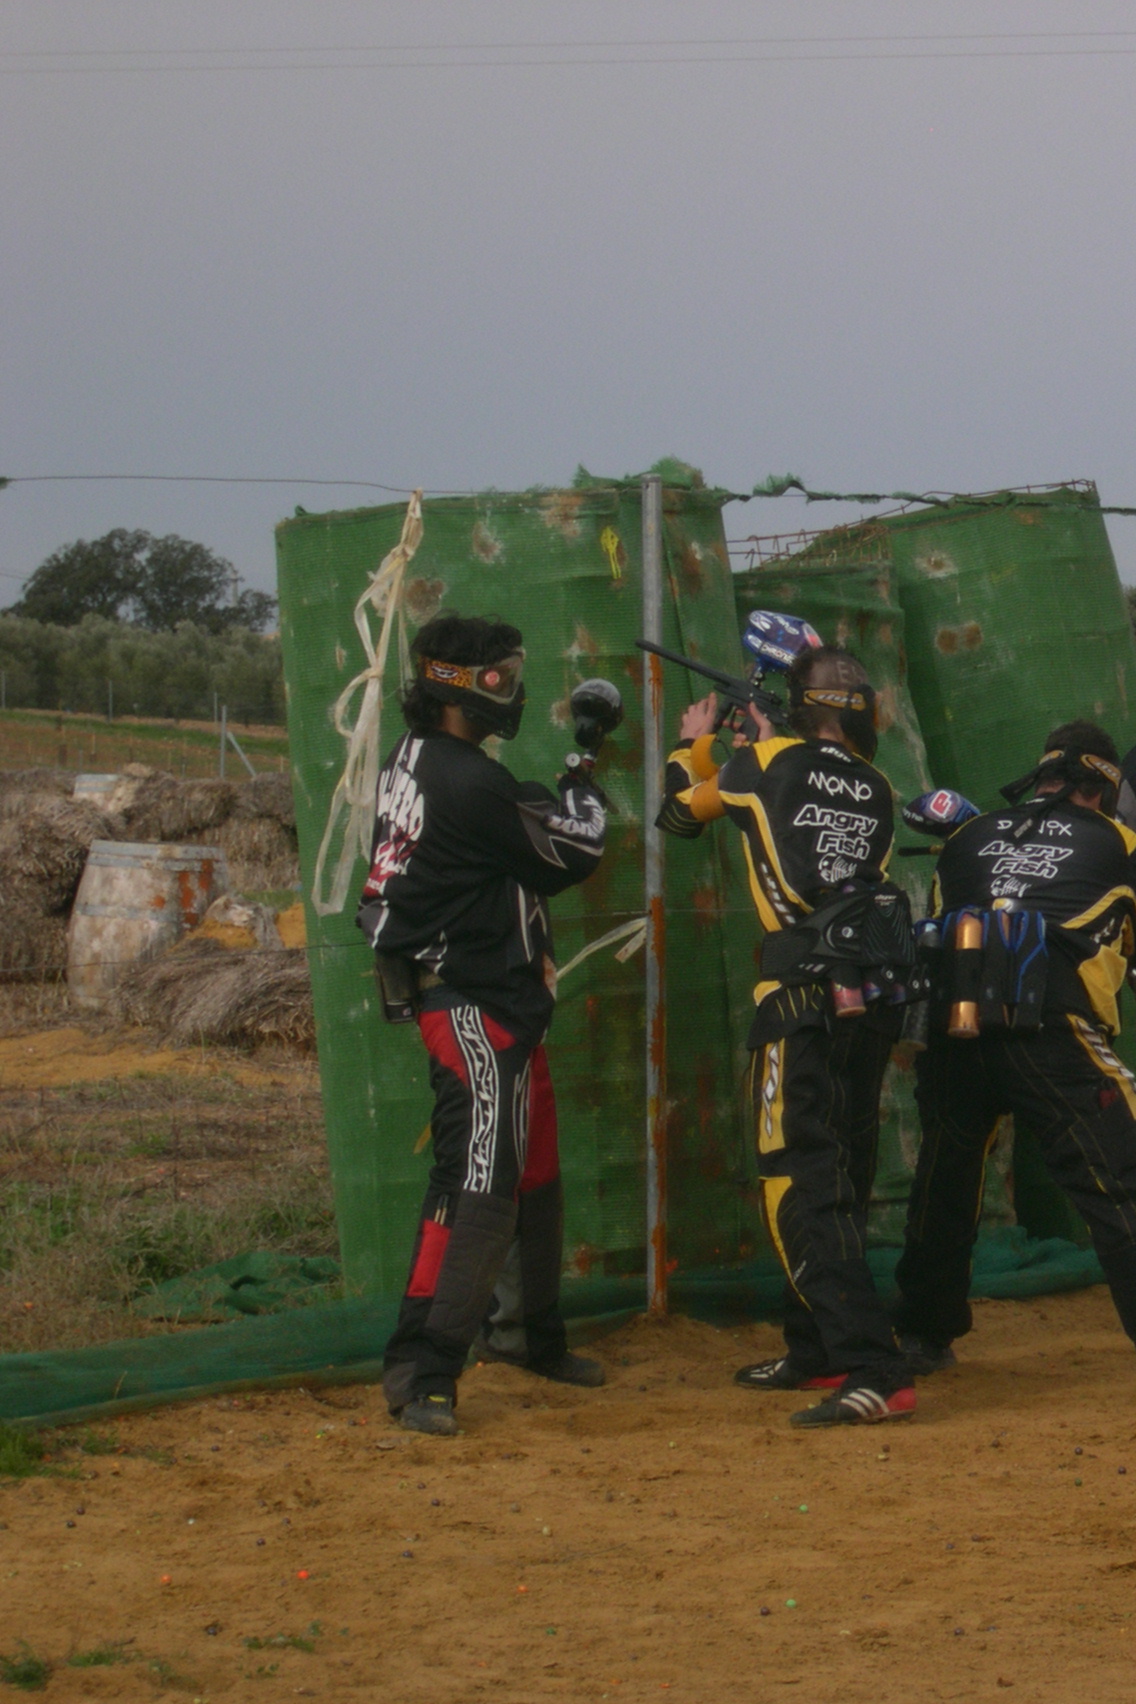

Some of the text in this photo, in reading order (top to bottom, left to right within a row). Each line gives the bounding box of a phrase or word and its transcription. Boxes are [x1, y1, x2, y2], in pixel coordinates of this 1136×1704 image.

[807, 770, 873, 803] MONO
[793, 803, 878, 837] Angry
[816, 830, 871, 861] Fish
[978, 840, 1074, 862] Angry
[991, 856, 1059, 879] Fish
